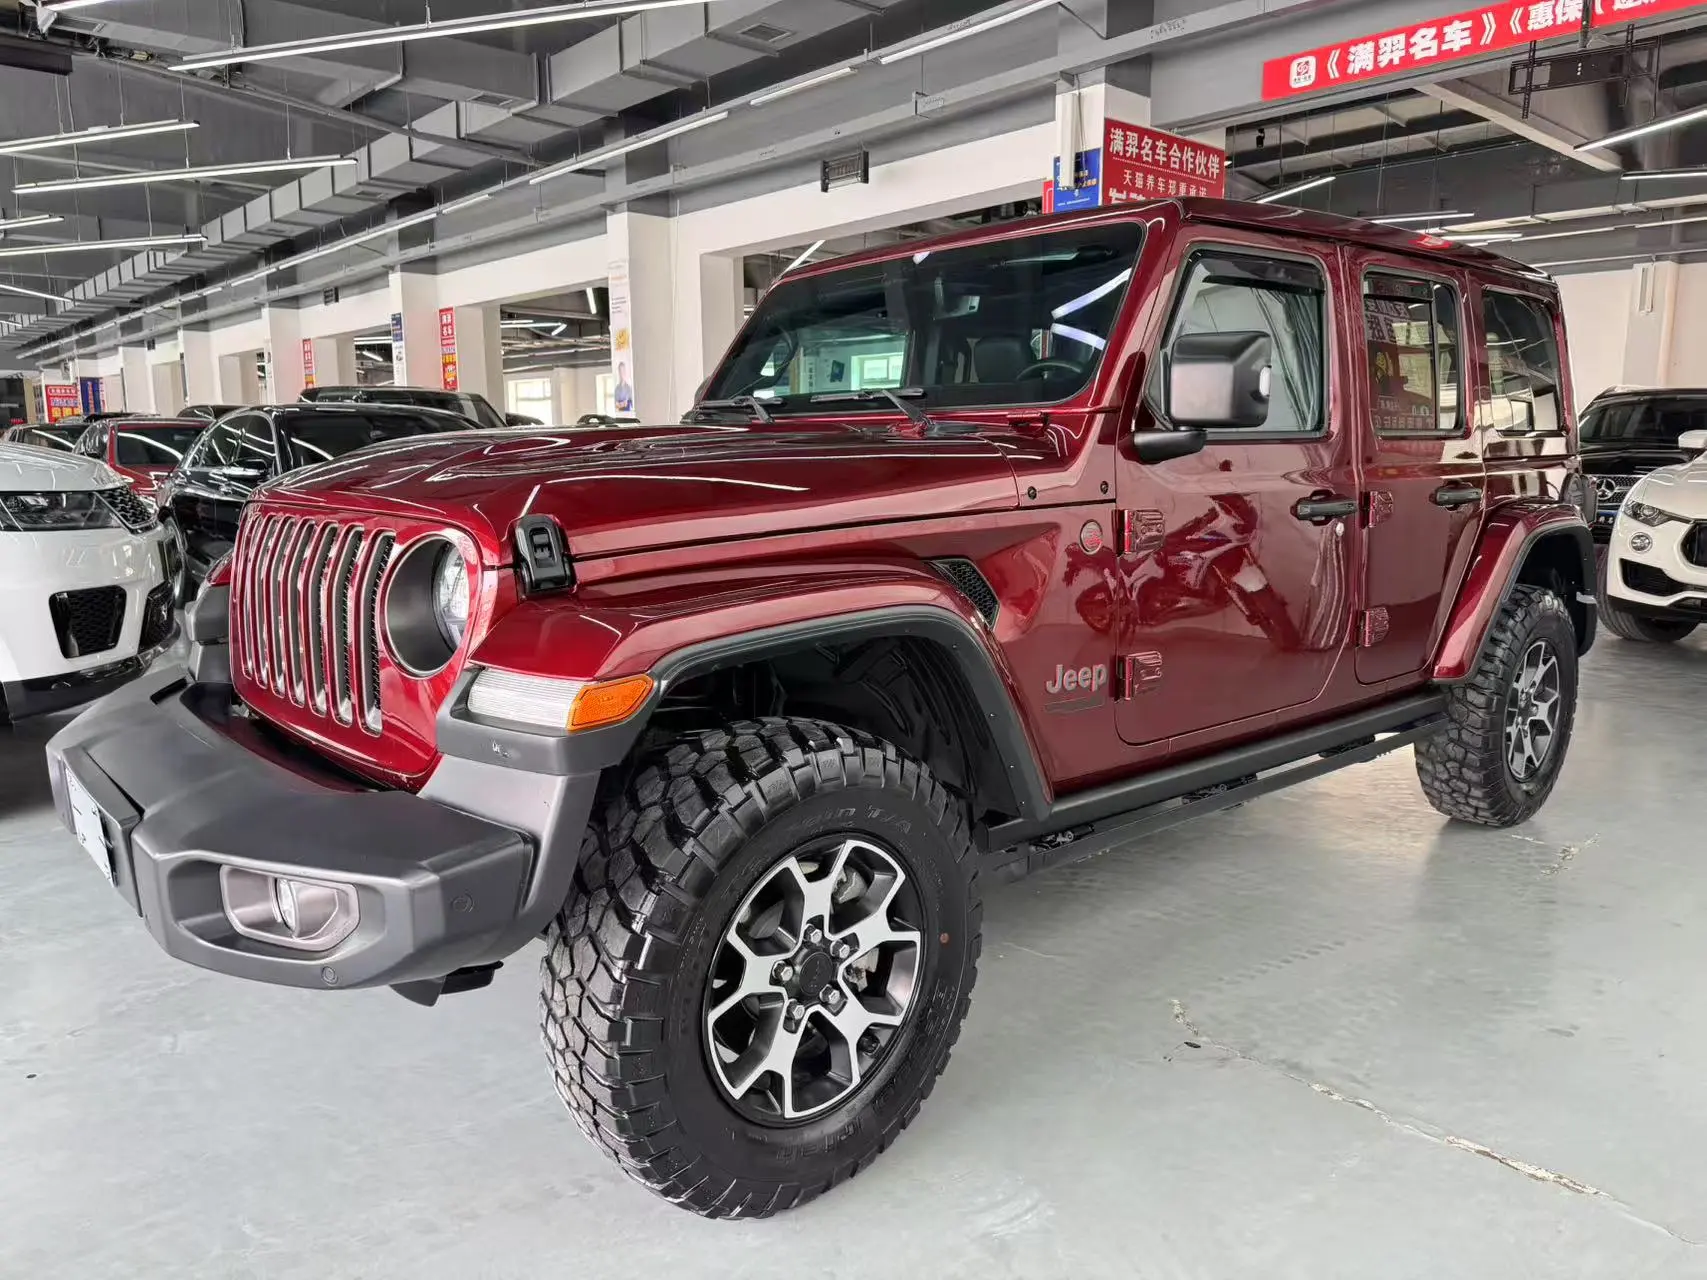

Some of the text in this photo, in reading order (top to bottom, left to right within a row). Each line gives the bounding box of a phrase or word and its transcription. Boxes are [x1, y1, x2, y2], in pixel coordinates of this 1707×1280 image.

[1109, 127, 1220, 179] 满羿名车合作伙伴
[1045, 663, 1108, 694] Jeep
